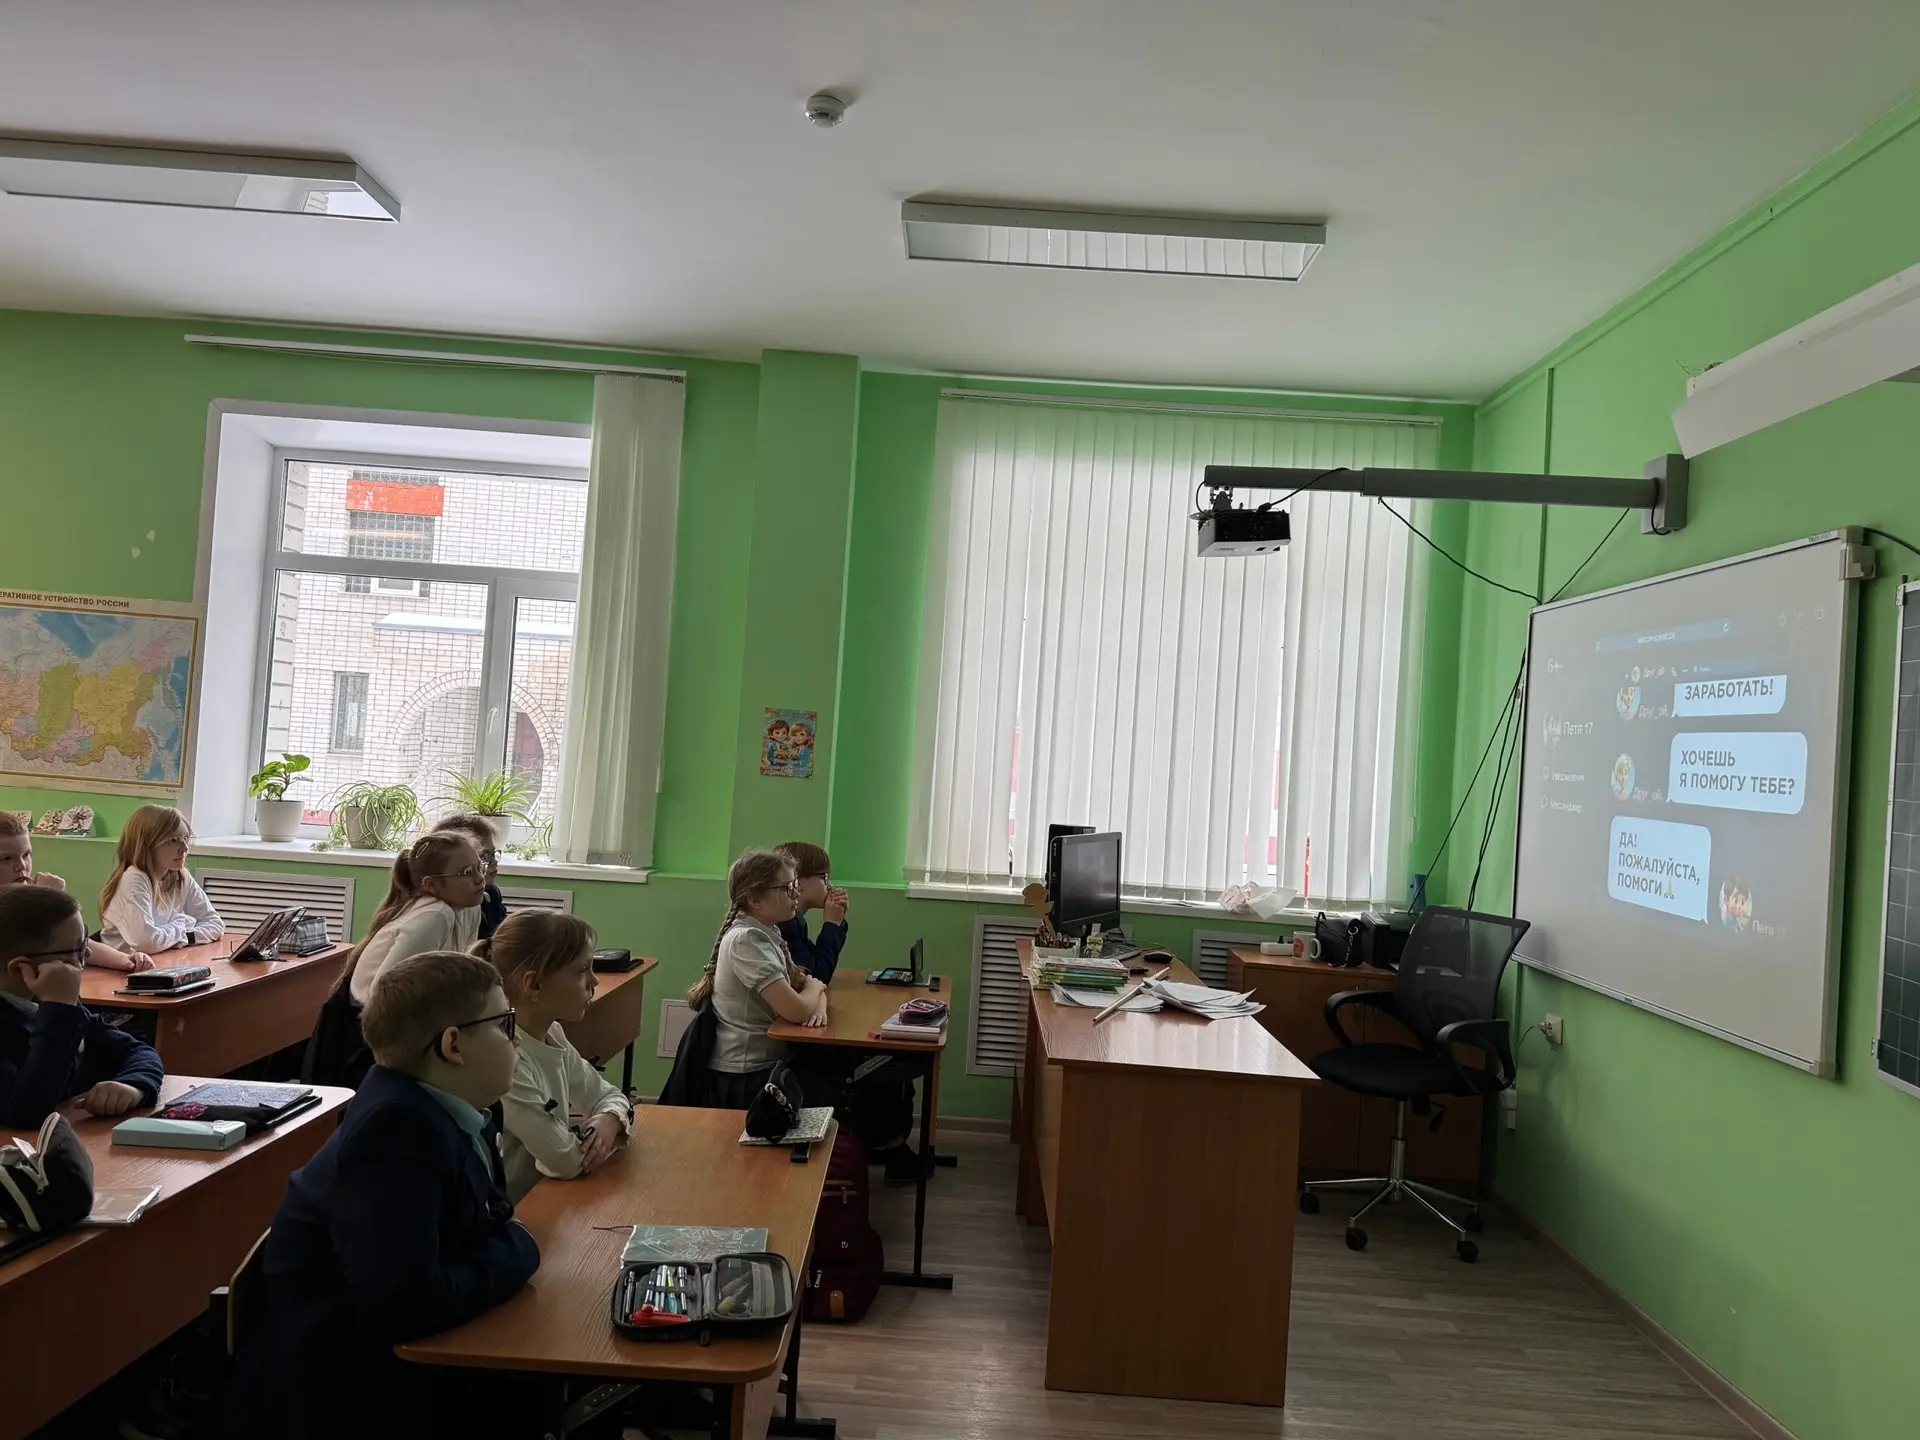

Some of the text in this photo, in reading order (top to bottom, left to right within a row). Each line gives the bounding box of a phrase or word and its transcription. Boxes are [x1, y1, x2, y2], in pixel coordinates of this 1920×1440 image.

[44, 594, 94, 605] УСТРОЙСТВО
[96, 599, 130, 609] РОССИИ
[1684, 679, 1774, 700] ЗАРАБОТАТЬ!
[1563, 721, 1582, 736] Петя
[1681, 750, 1736, 767] ХОЧЕШЬ
[1679, 773, 1795, 796] Я ПОМОГУ ТЕБЕ?
[1618, 831, 1638, 848] ДА!
[1618, 851, 1700, 886] ПОЖАЛУЙСТА,
[1617, 873, 1663, 897] ПОМОГИ
